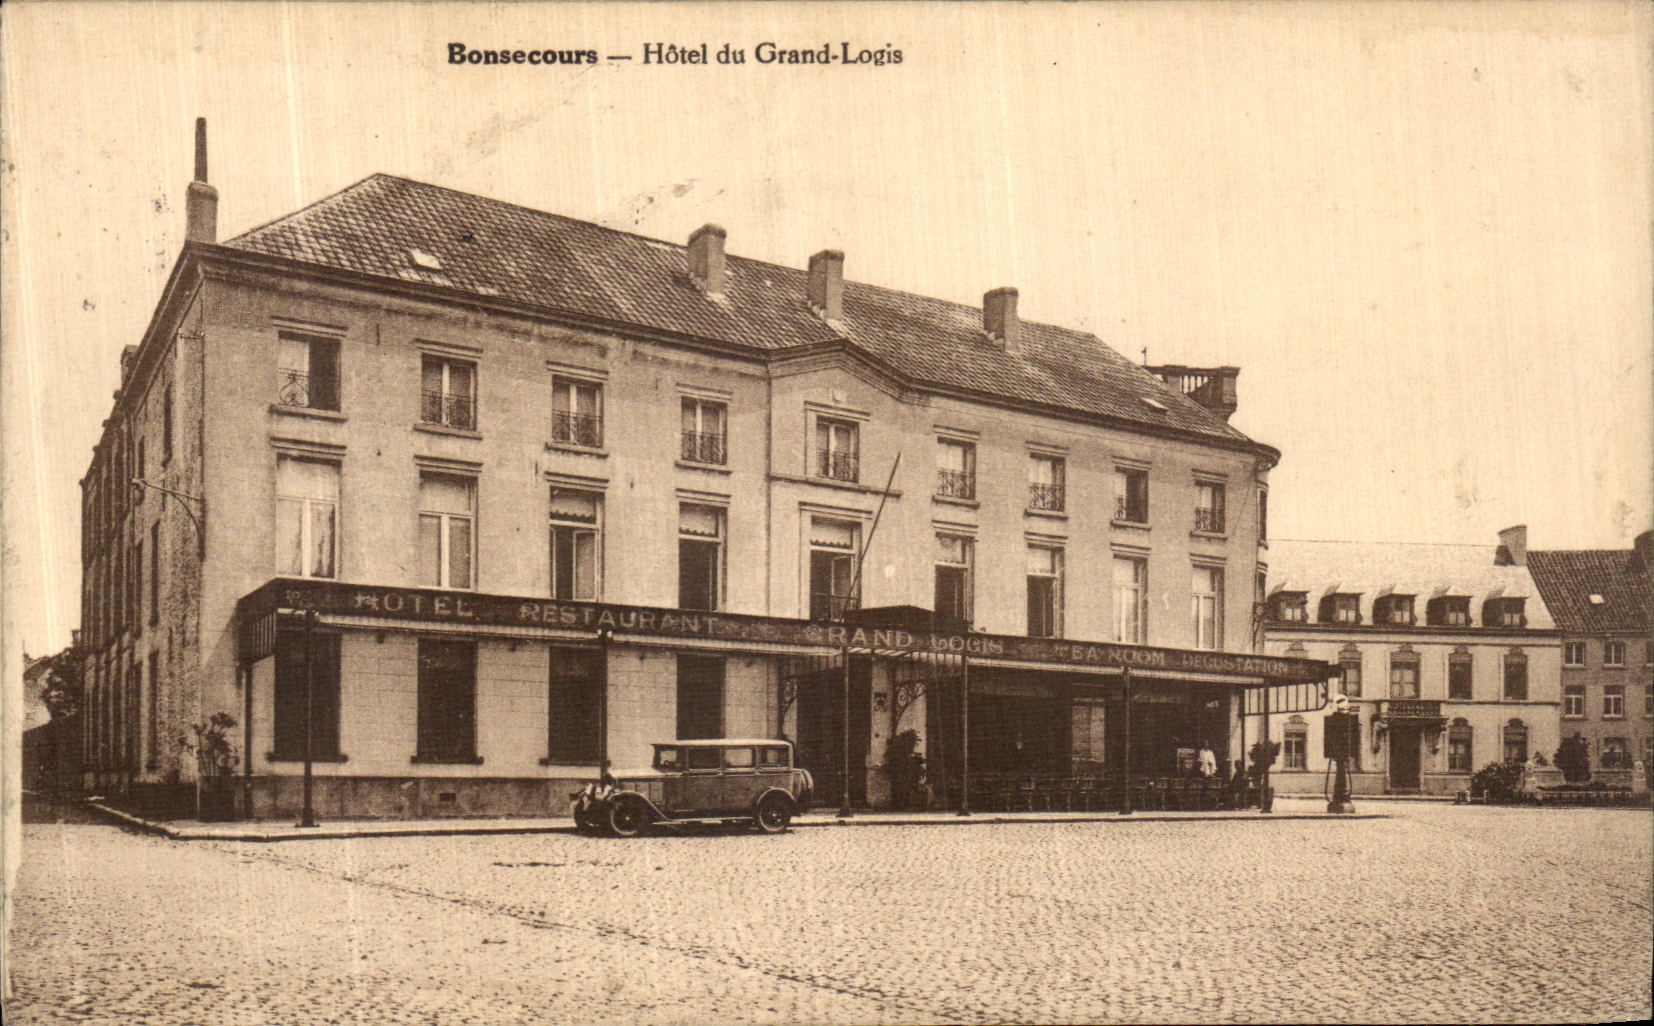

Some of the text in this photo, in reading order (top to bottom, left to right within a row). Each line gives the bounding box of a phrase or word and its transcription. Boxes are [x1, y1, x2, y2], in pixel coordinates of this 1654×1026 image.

[354, 591, 473, 617] HOTEL
[519, 602, 718, 634] RESTAURANT
[803, 624, 913, 649] GRAND
[930, 633, 1003, 654] LOGIS
[1107, 648, 1166, 667] ROOM
